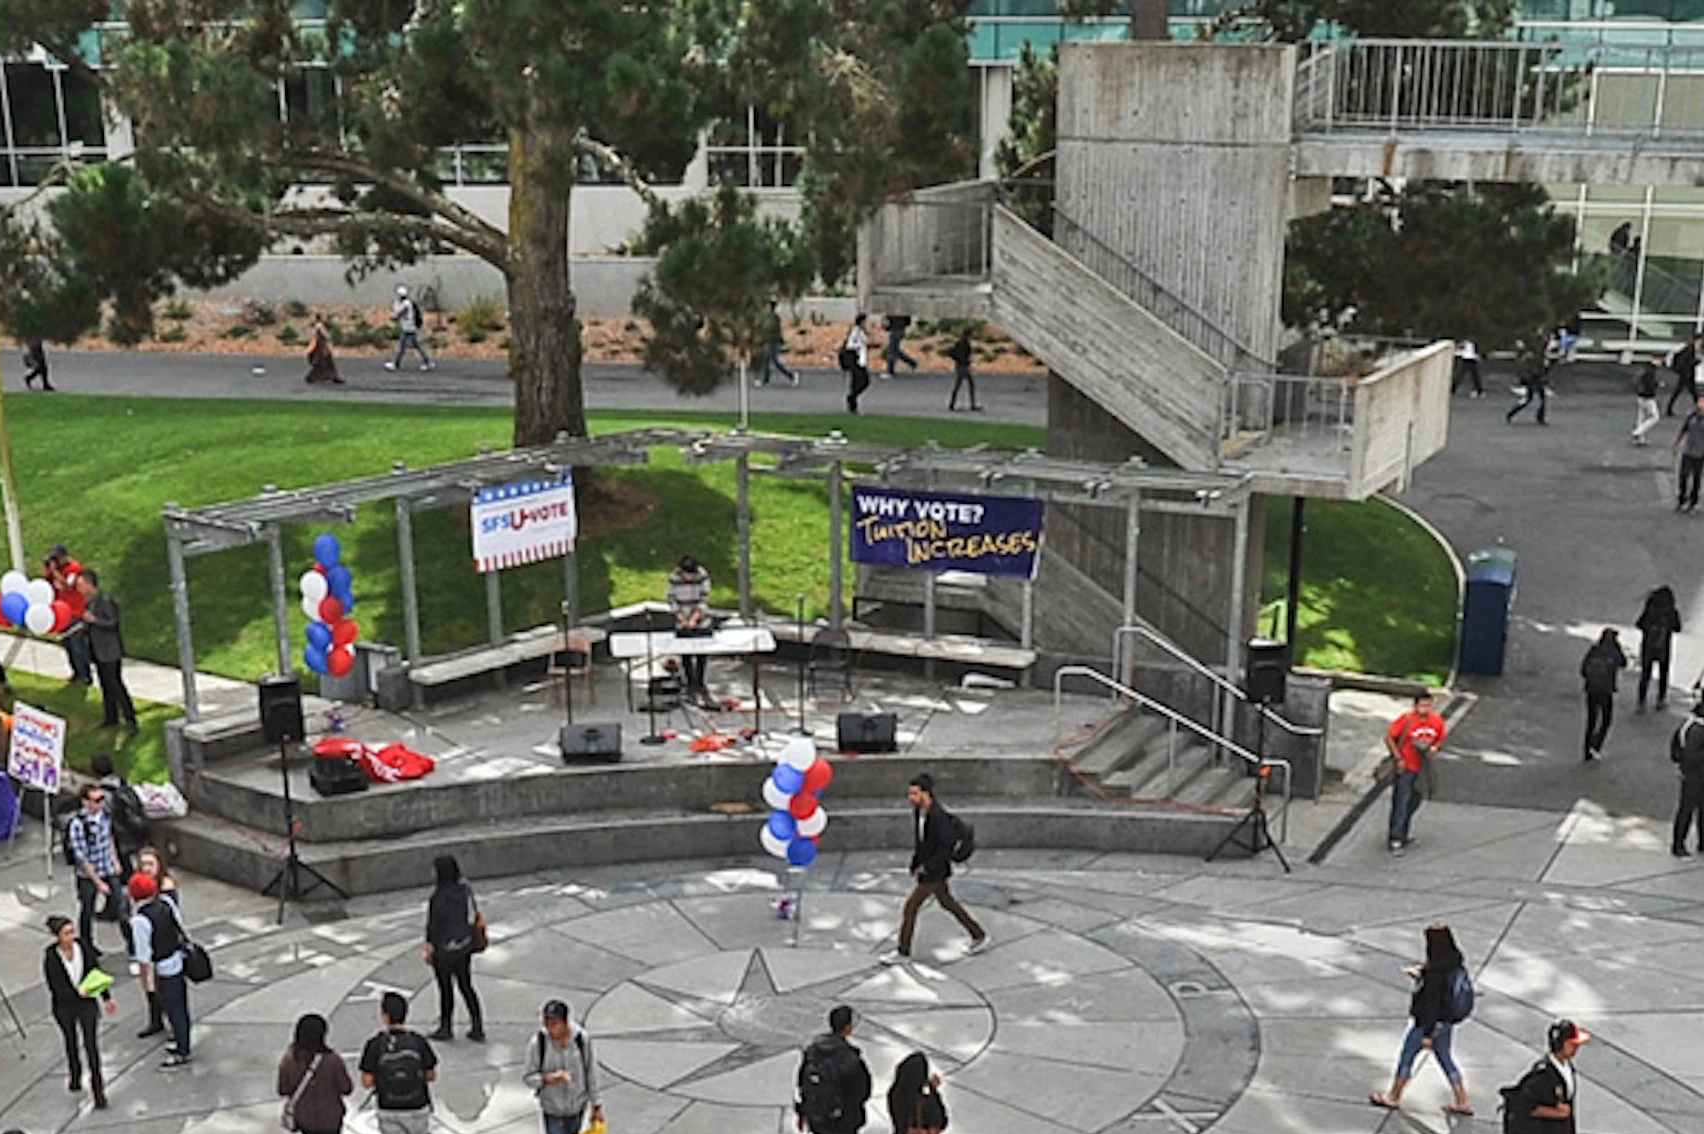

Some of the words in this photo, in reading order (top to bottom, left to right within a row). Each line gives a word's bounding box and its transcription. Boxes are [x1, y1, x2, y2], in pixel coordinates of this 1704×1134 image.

[529, 501, 568, 523] VOTE
[857, 494, 910, 518] WHY
[913, 499, 984, 524] VOTE?
[907, 530, 1037, 565] INCREASES
